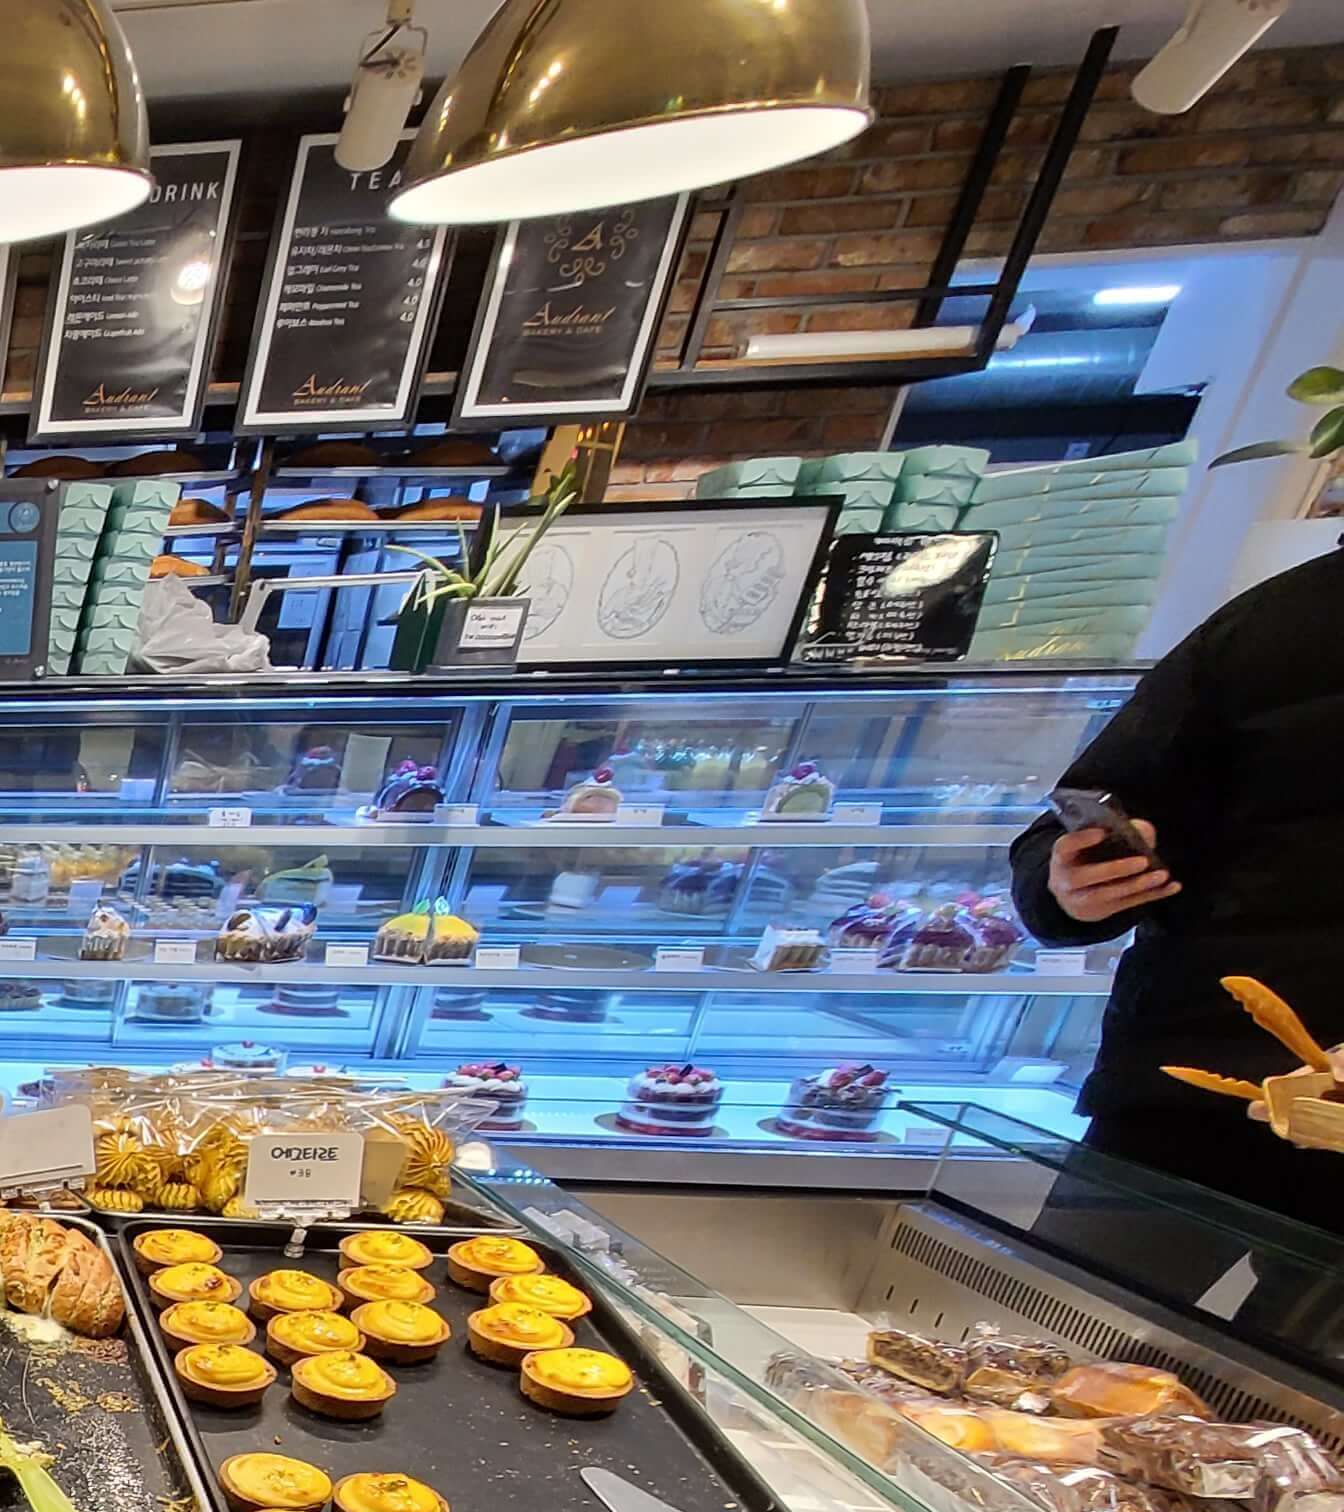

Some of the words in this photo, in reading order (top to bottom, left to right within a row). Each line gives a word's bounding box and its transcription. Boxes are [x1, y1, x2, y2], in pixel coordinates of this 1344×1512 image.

[349, 170, 403, 191] TEA
[149, 181, 220, 204] DRINK
[271, 1147, 340, 1162] 에그타르트
